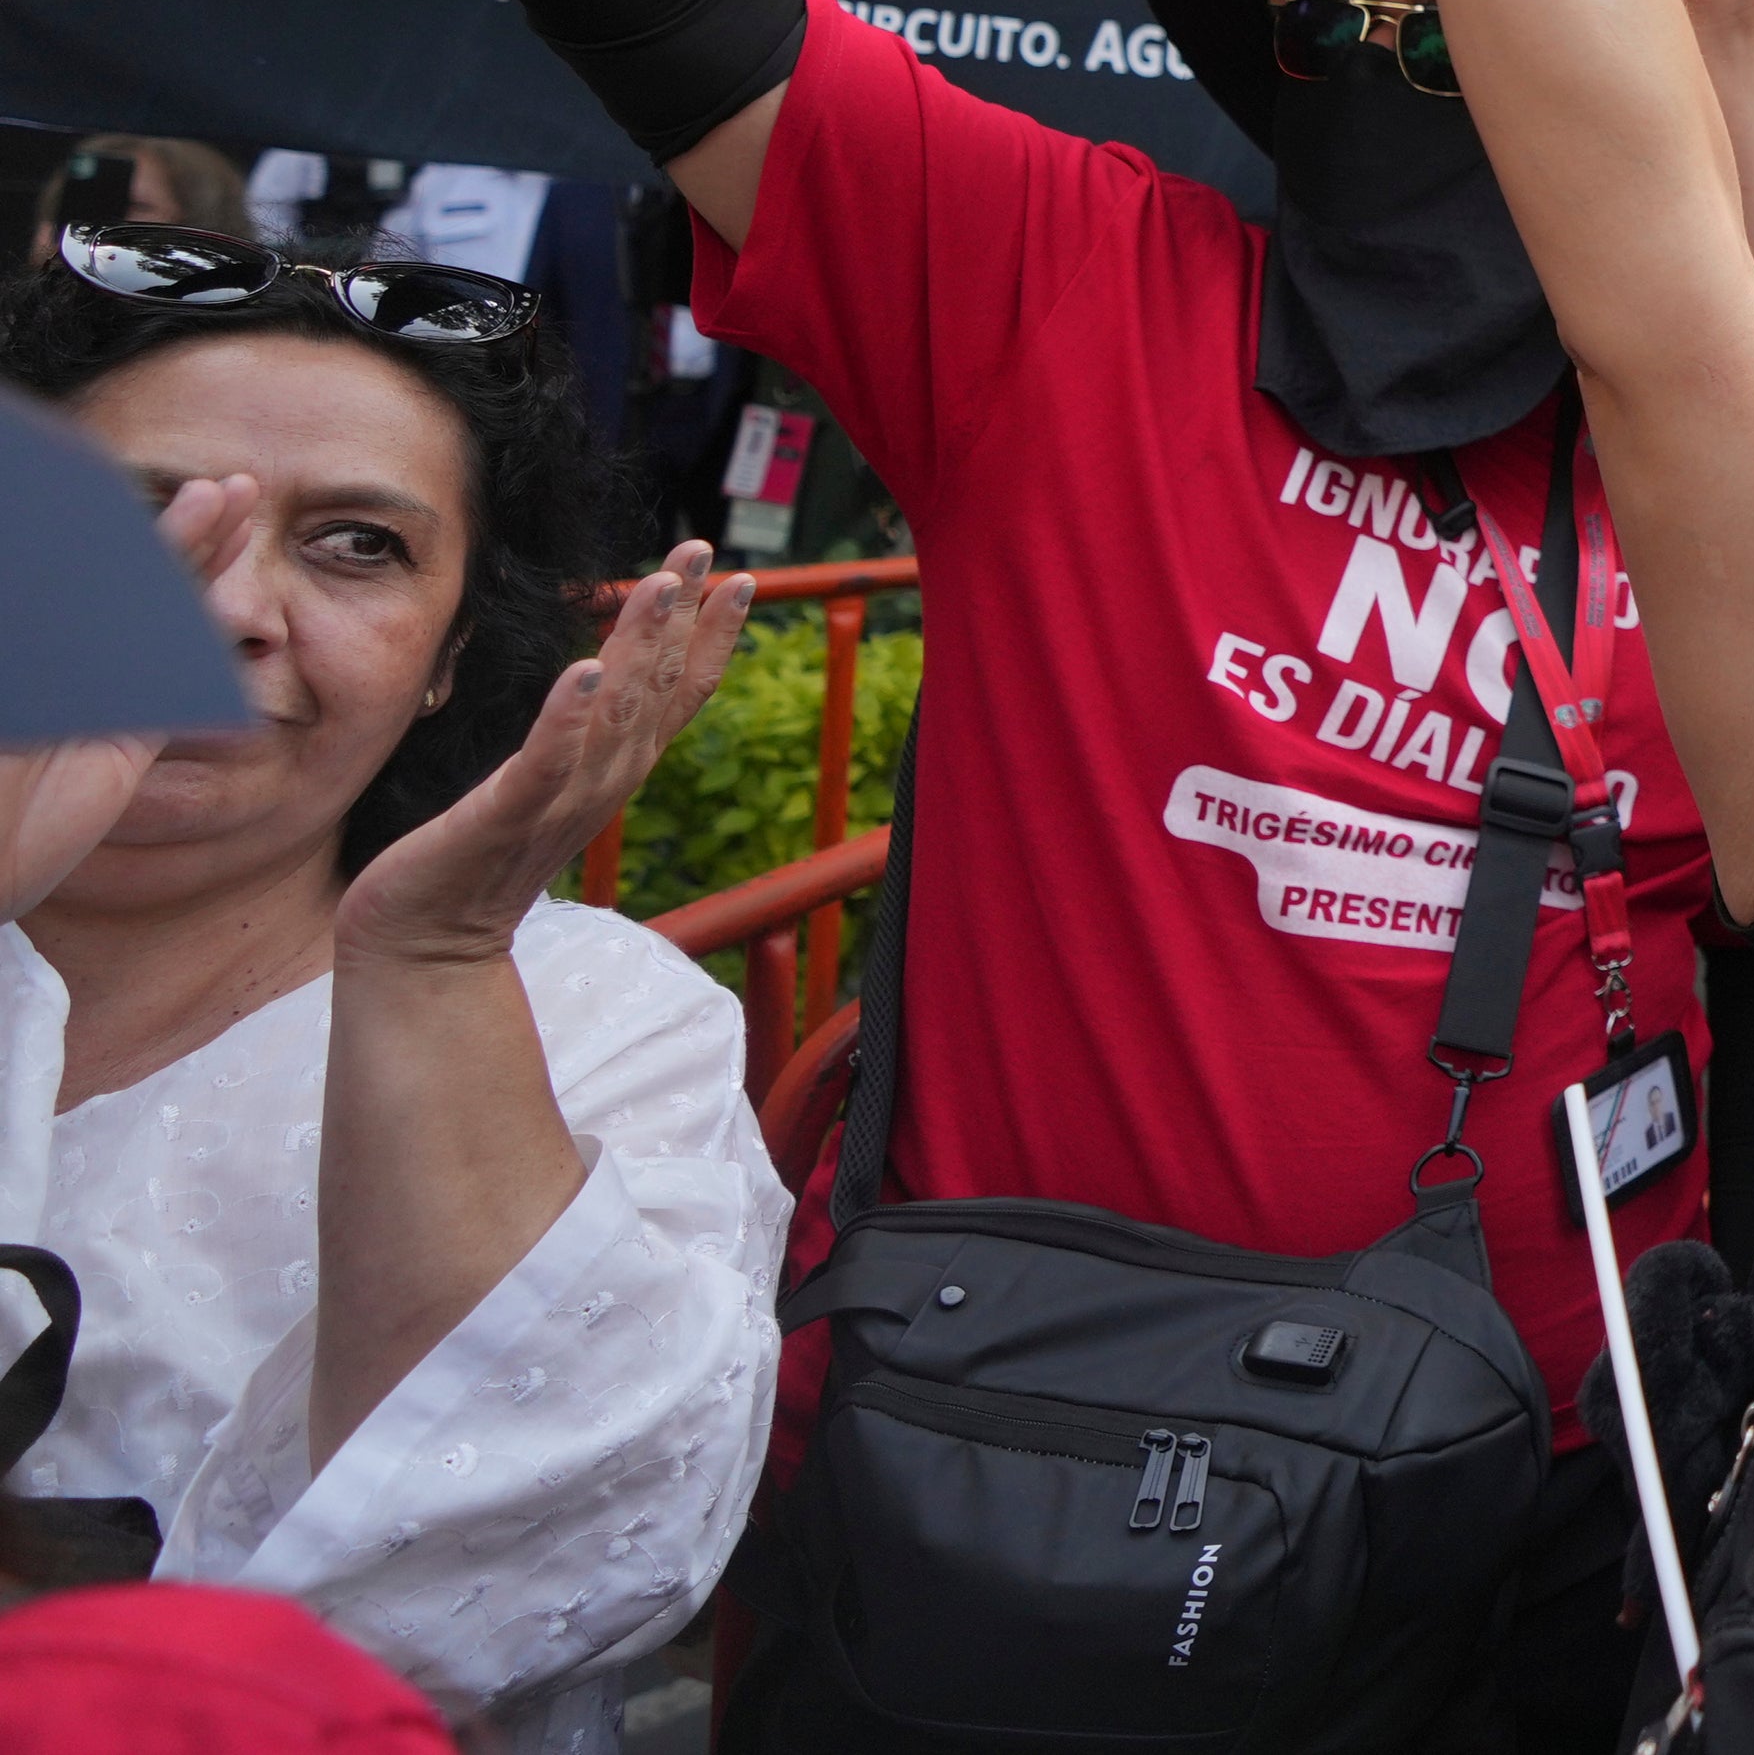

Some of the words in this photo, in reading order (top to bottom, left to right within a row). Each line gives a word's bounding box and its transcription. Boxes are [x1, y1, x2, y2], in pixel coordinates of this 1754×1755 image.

[1207, 632, 1313, 723] ES
[1193, 791, 1416, 859] TRIGÉSIMO
[1279, 885, 1465, 937] PRESENT
[1168, 1544, 1222, 1666] FASHION
